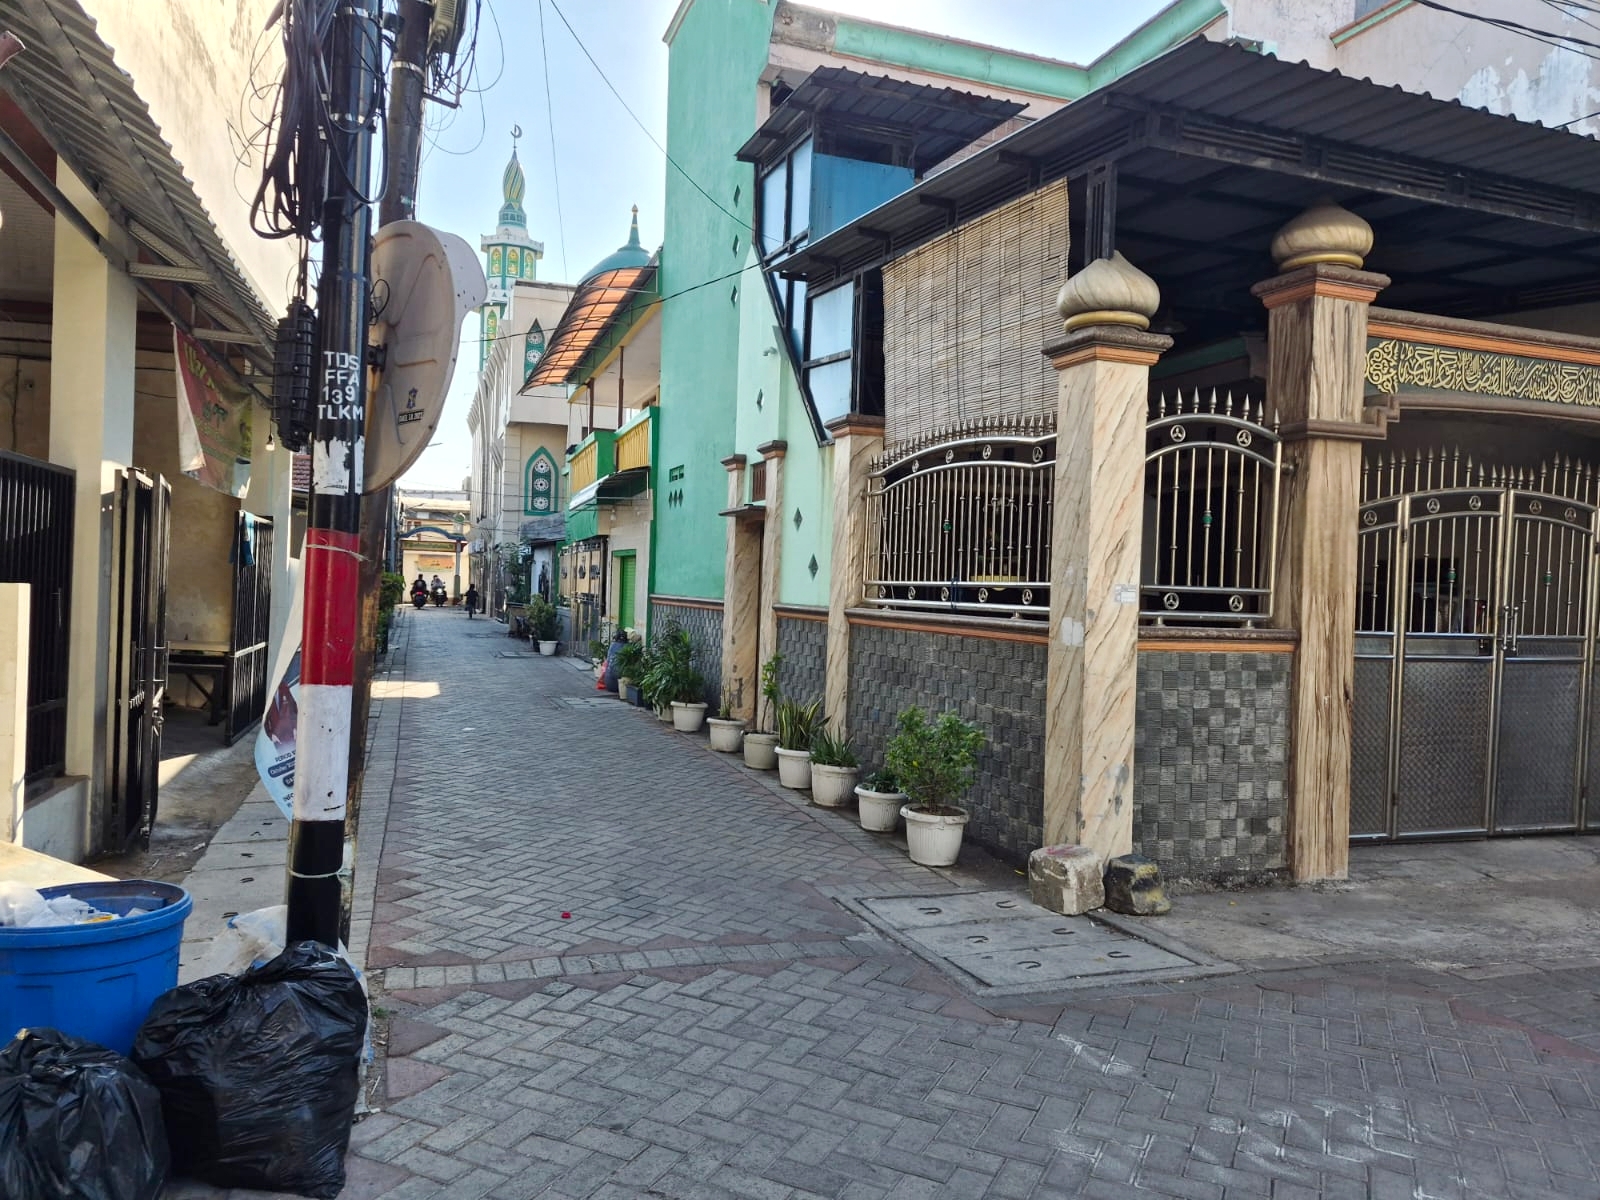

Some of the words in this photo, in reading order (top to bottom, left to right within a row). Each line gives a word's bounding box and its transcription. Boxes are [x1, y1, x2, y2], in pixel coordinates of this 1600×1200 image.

[324, 351, 360, 370] TDS
[325, 369, 360, 387] FFA
[322, 385, 356, 405] 139
[317, 404, 363, 421] TLKM
